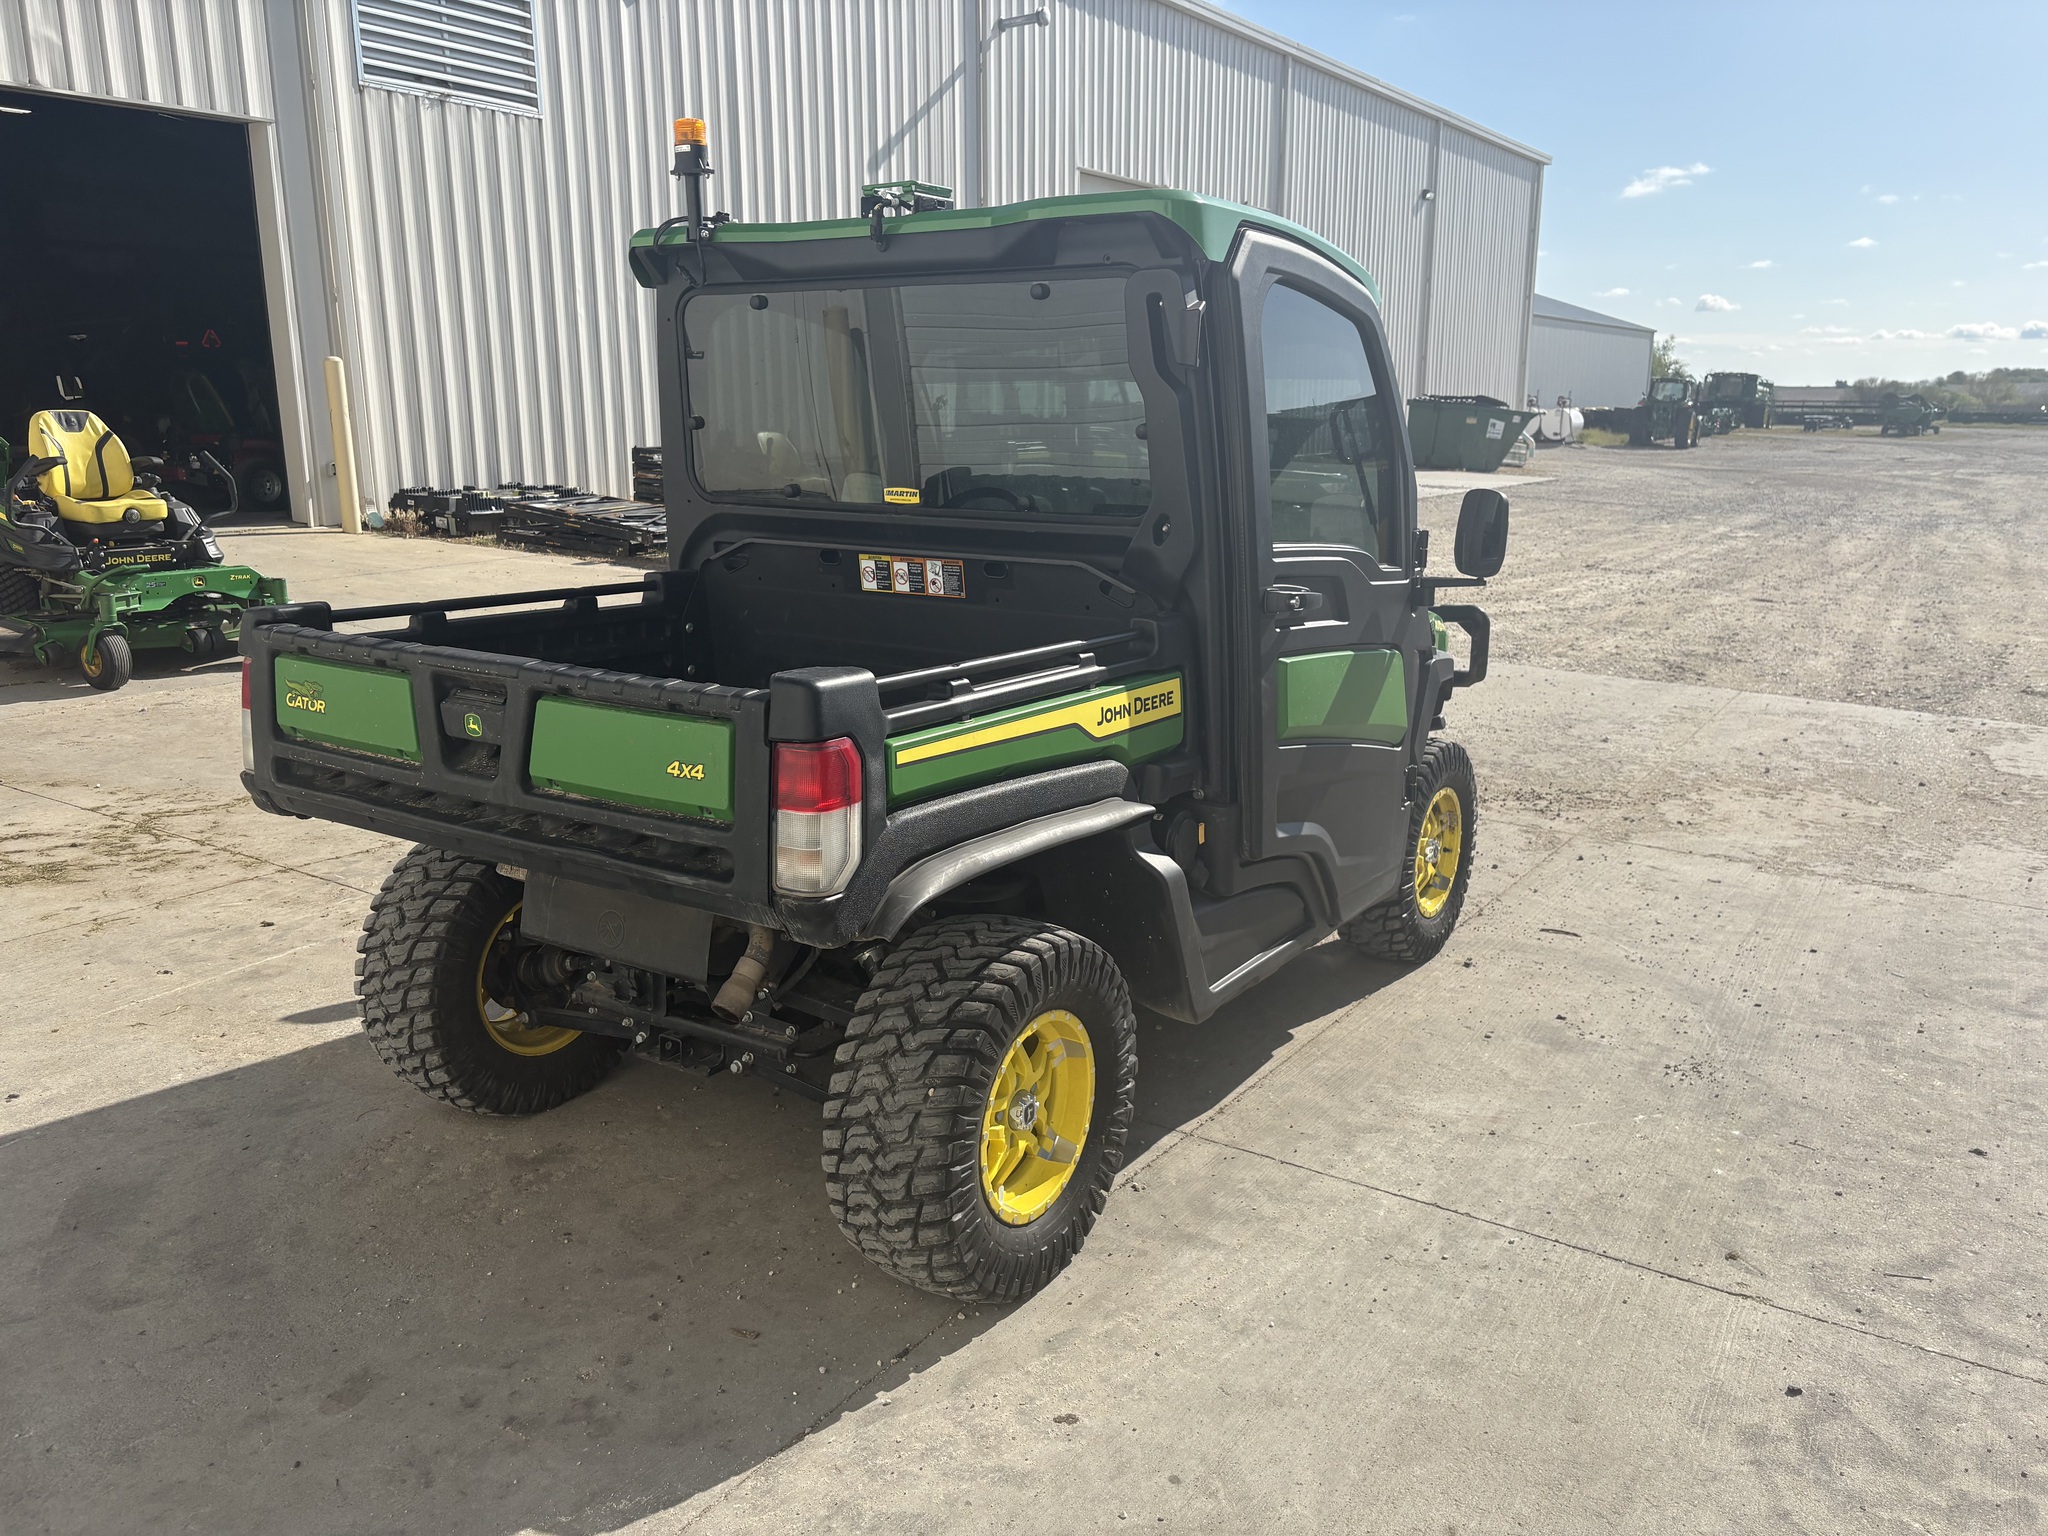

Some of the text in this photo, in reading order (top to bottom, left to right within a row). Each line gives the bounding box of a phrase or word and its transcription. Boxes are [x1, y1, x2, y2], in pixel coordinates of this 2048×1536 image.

[105, 553, 172, 566] JOHN DEERE
[285, 692, 326, 713] GATOR
[1096, 690, 1174, 726] JOHN DEERE
